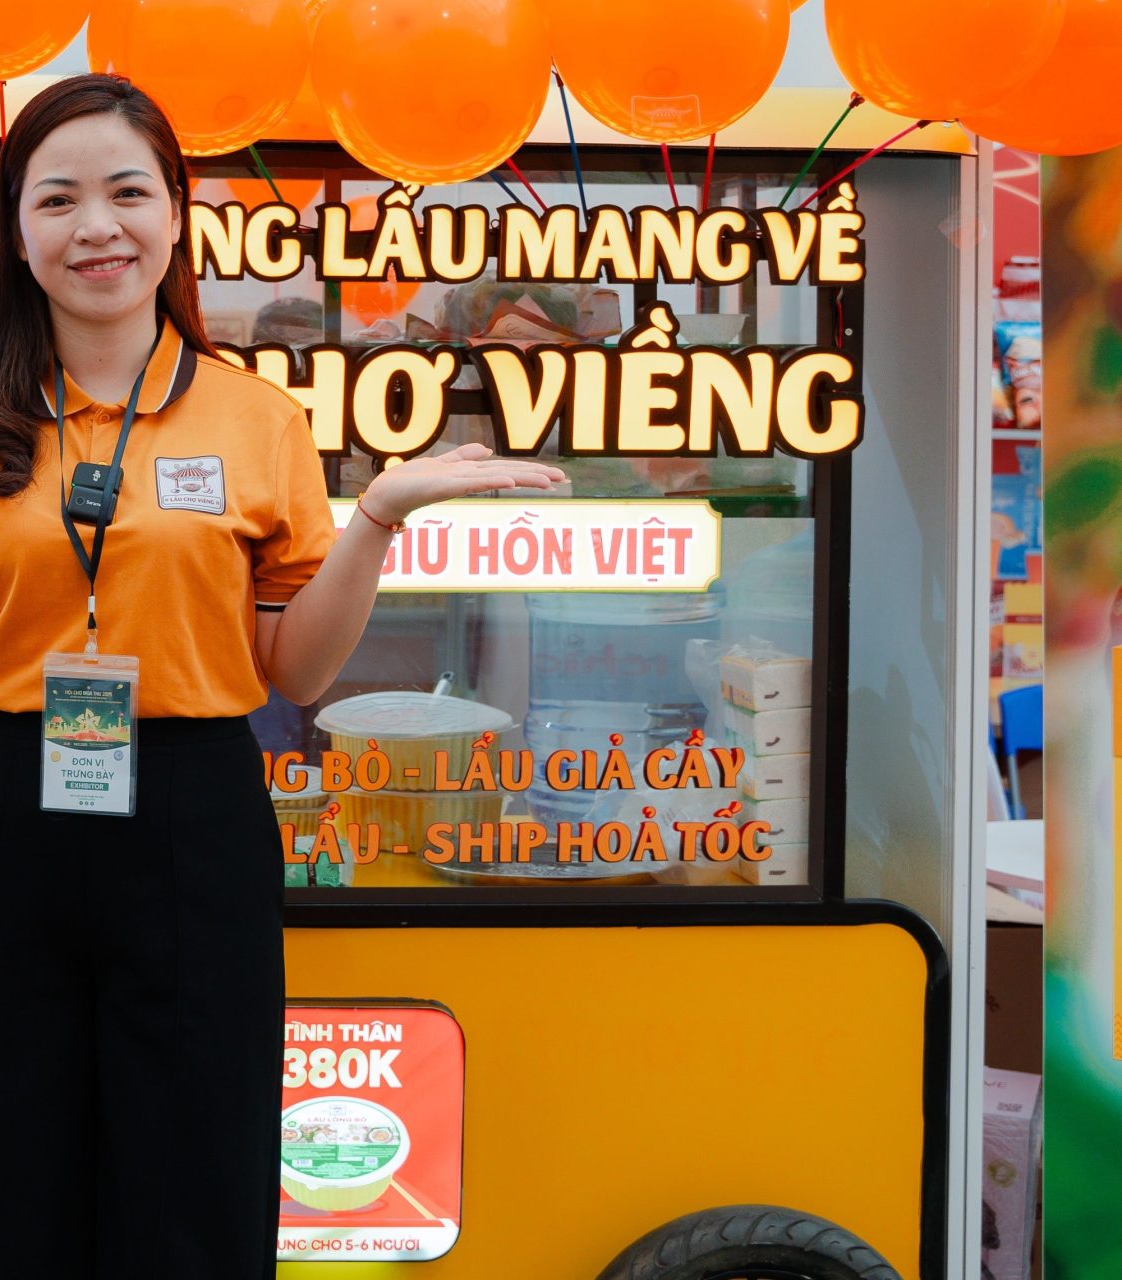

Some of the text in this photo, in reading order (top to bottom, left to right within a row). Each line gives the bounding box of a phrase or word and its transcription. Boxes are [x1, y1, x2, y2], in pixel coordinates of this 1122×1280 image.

[323, 183, 486, 280] LẨU
[504, 206, 751, 281] MANG
[763, 181, 865, 282] VỀ
[216, 307, 860, 472] HỢ VIỀNG
[468, 511, 572, 576] HỒN
[590, 516, 693, 582] VIỆT
[61, 769, 115, 780] TRƯNG BÀY
[71, 756, 93, 766] ĐƠN
[320, 739, 391, 792] BÒ
[434, 730, 534, 792] LẨU
[544, 733, 636, 792] GIẢ
[70, 782, 104, 790] EXHIBITOR
[280, 801, 382, 865] LẨU
[424, 822, 547, 864] SHIP
[557, 806, 669, 863] HOẢ
[673, 800, 773, 863] TỐC
[284, 1020, 403, 1043] TÌNH THÂN
[282, 1047, 403, 1089] 380K
[277, 1234, 420, 1254] ỤNG CHO 5-6 NGƯỜI
